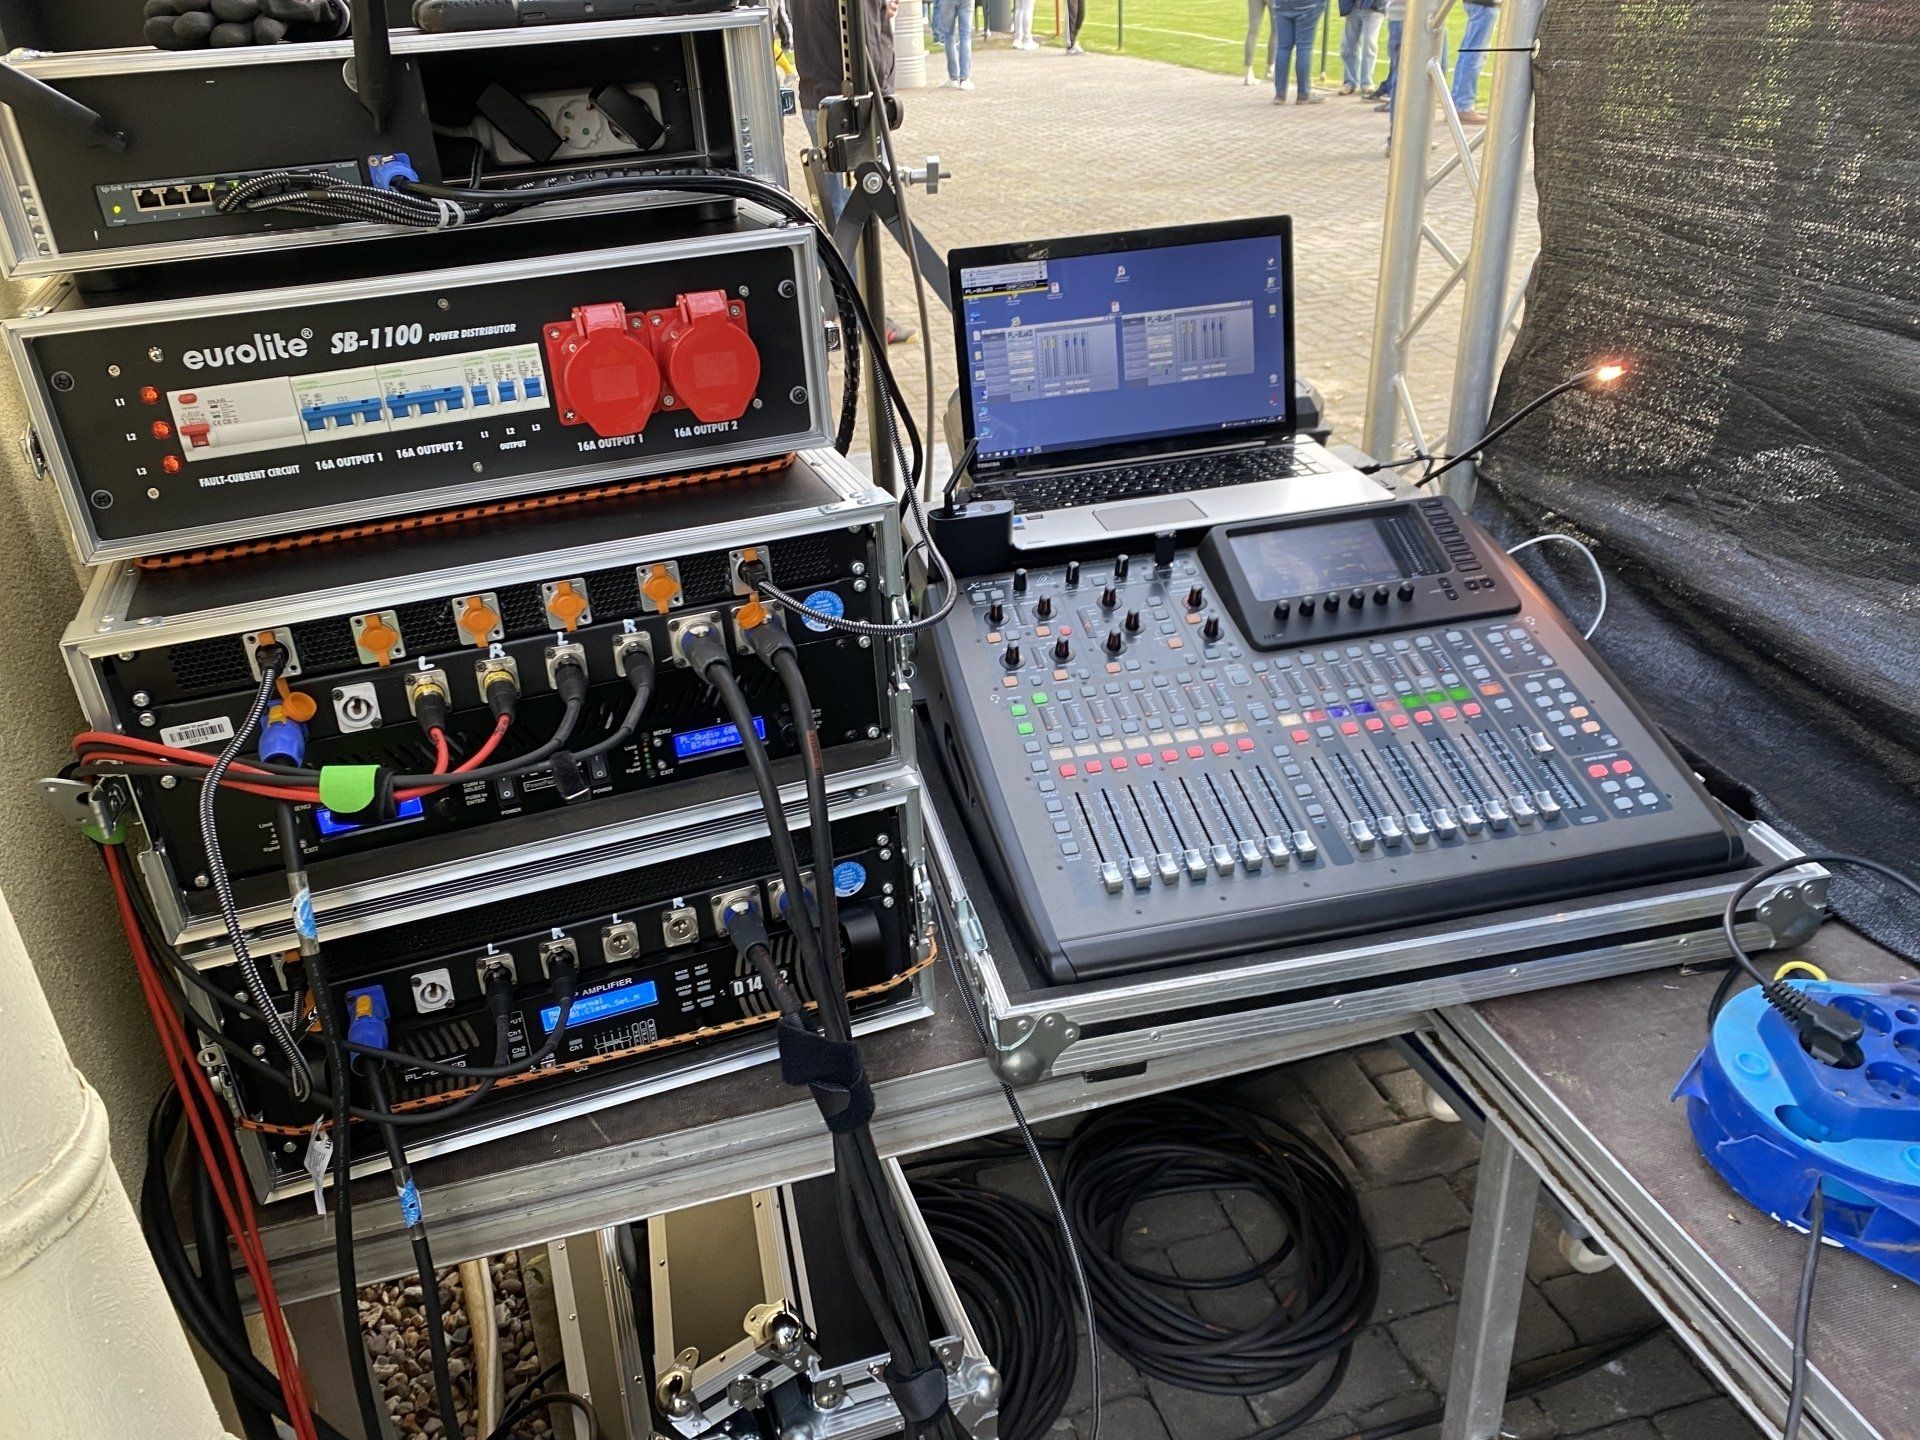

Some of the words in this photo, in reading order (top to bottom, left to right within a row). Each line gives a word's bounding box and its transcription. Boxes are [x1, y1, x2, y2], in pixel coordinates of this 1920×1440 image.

[101, 184, 123, 193] tp-link
[331, 323, 423, 354] SB-1100
[429, 330, 460, 342] POWER
[461, 323, 517, 338] DISTRIBUTOR
[115, 398, 126, 407] L1
[505, 427, 515, 435] L2
[531, 423, 541, 431] L3
[674, 427, 692, 438] 16A
[693, 422, 730, 435] OUTPUT
[731, 420, 738, 431] 2
[126, 432, 137, 442] L2
[499, 439, 527, 450] OUTPUT
[577, 440, 597, 452] 16A
[598, 435, 636, 449] OUTPUT
[638, 433, 644, 444] 1
[396, 447, 416, 459] 16A
[416, 441, 455, 456] OUTPUT
[456, 440, 464, 450] 2
[315, 459, 335, 471] 16A
[337, 453, 375, 469] OUTPUT
[377, 452, 383, 462] 1
[136, 467, 147, 476] L3
[199, 469, 266, 488] FAULT-CURRENT
[267, 464, 300, 478] CIRCUIT
[623, 618, 637, 633] R
[557, 631, 569, 645] L
[489, 642, 506, 659] R
[418, 655, 435, 671] L
[653, 727, 672, 736] MENU
[660, 768, 674, 776] EXIT
[463, 784, 486, 793] SELECT
[592, 785, 613, 795] POWER
[466, 797, 486, 806] ENTER
[501, 807, 522, 815] POWER
[303, 846, 319, 854] EXIT
[672, 896, 686, 909] R
[612, 912, 622, 924] L
[551, 927, 566, 940] R
[487, 942, 500, 956] L
[674, 968, 688, 976] BACK
[582, 977, 633, 996] AMPLIFIER
[675, 984, 692, 992] ENTER
[733, 981, 744, 996] D
[508, 1029, 522, 1037] Ch1
[512, 1045, 526, 1053] Ch2
[569, 1044, 583, 1052] Ch1
